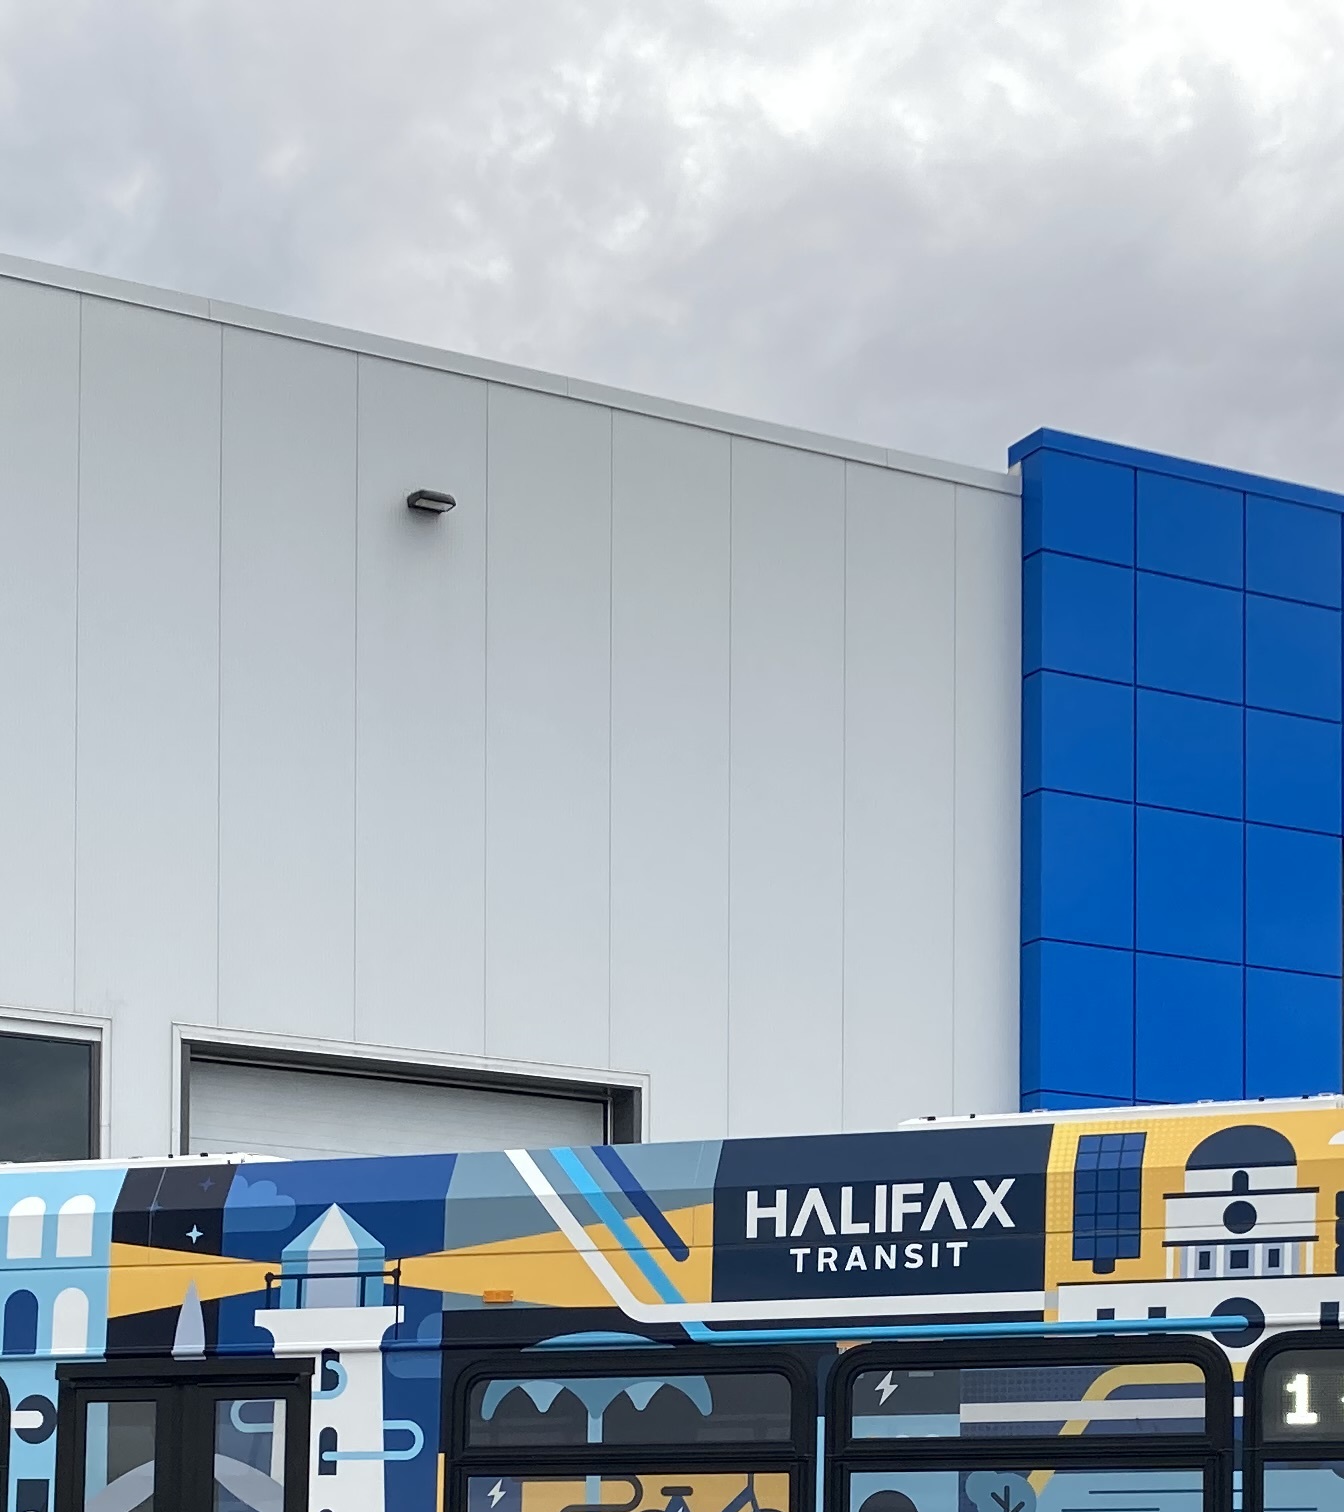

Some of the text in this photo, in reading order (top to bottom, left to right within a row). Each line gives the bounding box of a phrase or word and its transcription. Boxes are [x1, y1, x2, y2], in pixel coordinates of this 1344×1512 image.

[745, 1177, 1016, 1239] HALIFAX
[789, 1241, 968, 1273] TRANSIT
[1284, 1372, 1320, 1425] 1
